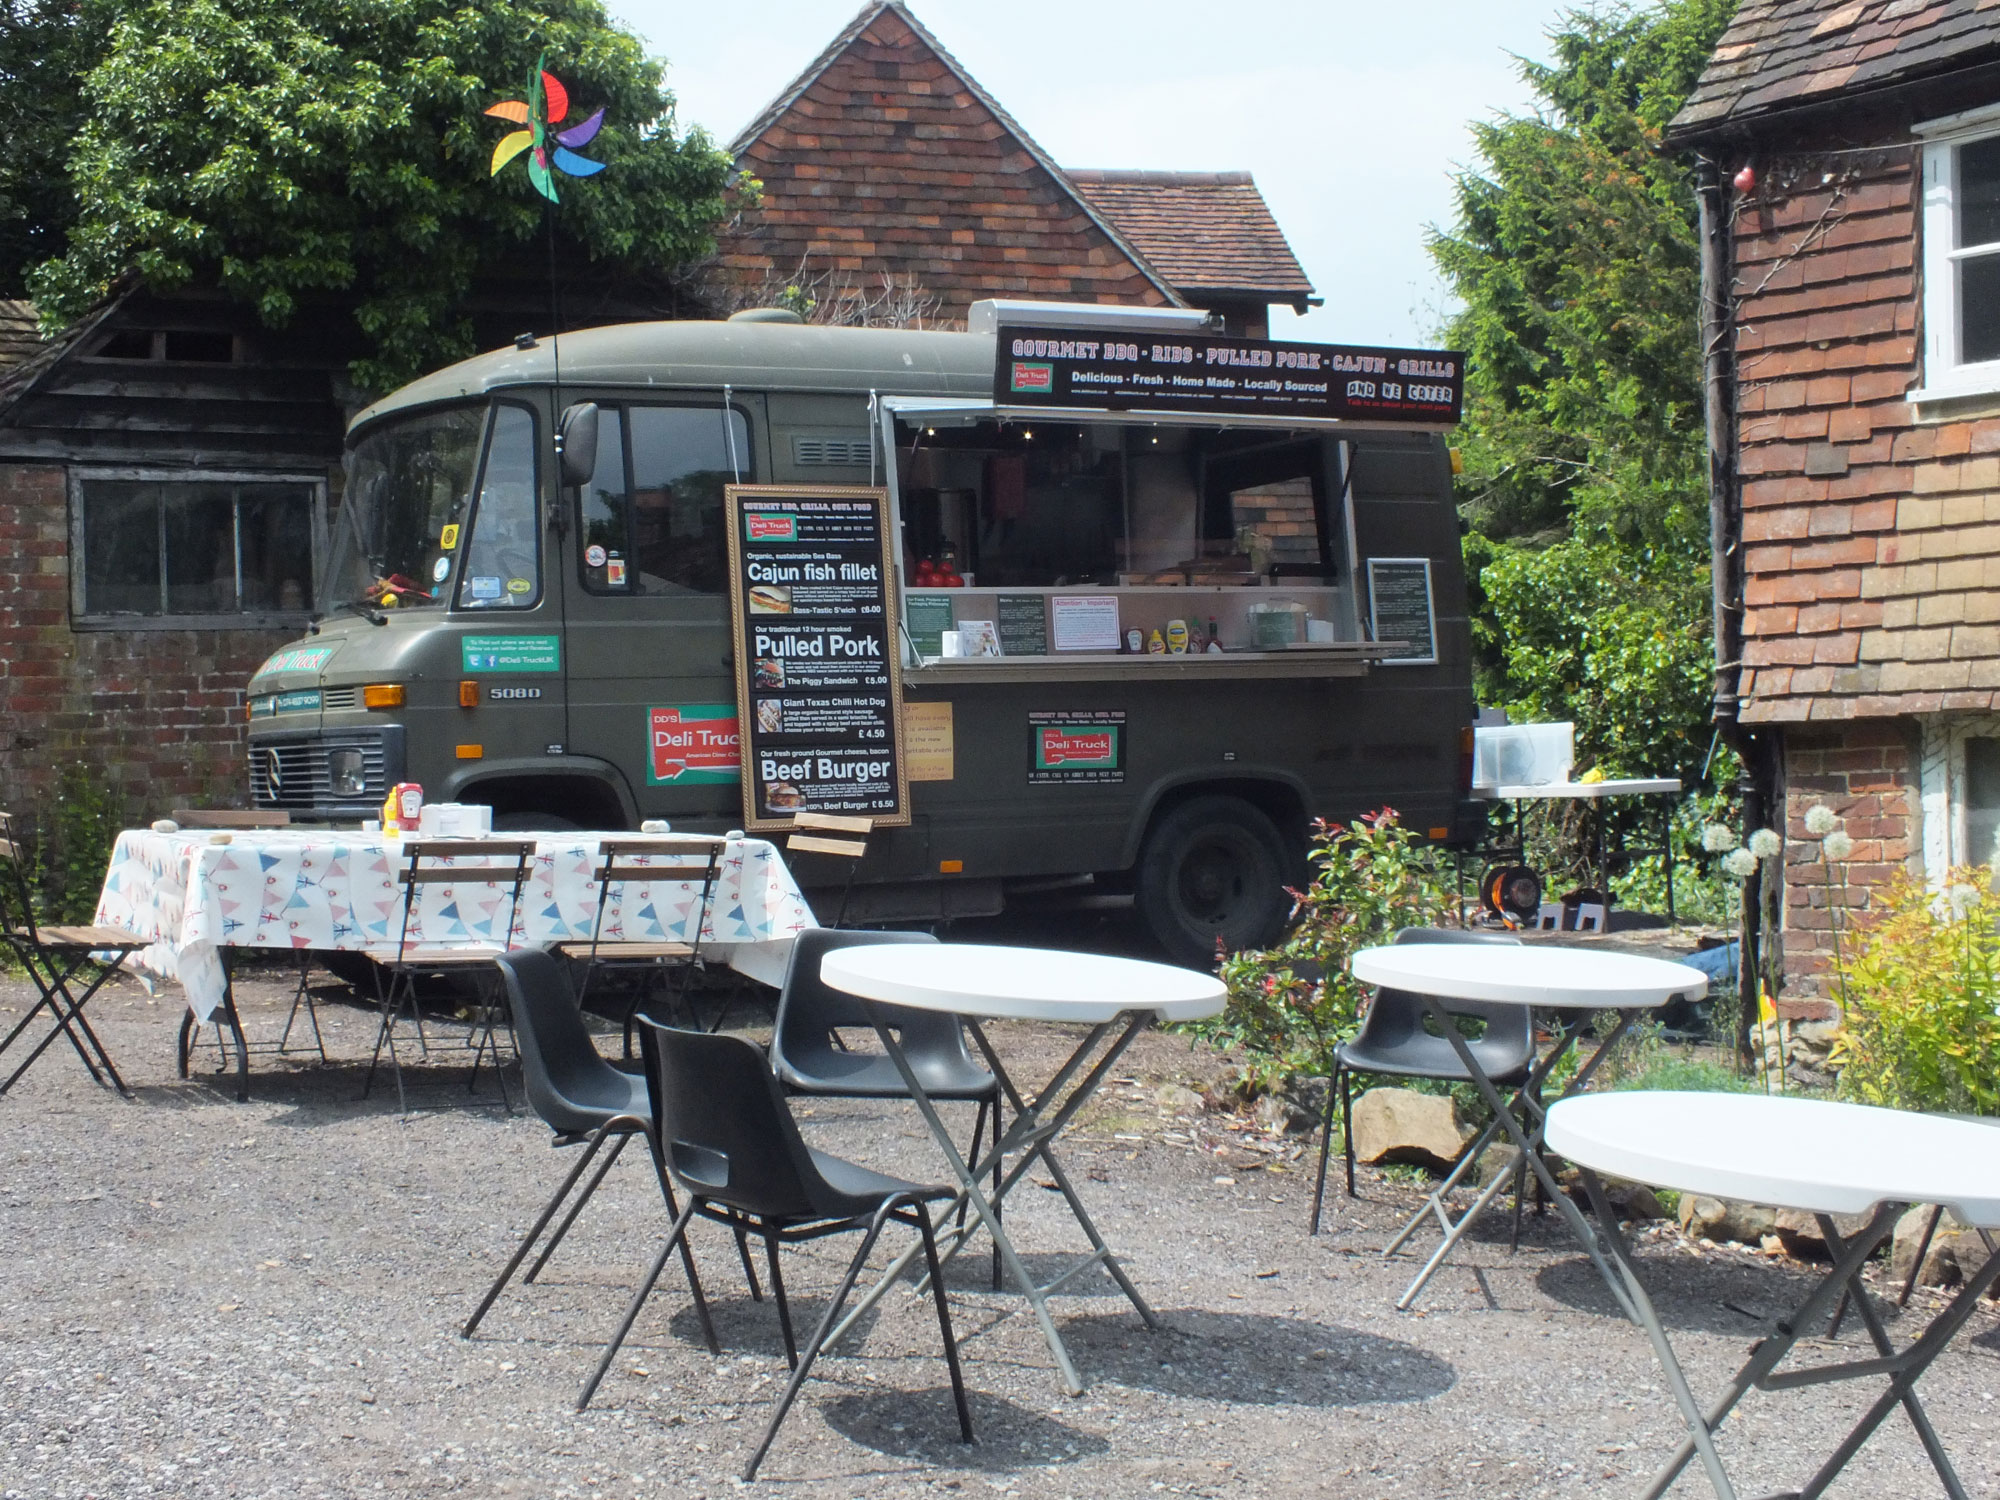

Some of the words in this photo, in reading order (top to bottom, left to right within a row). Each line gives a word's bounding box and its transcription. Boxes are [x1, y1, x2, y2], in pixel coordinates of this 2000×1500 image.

[1012, 339, 1099, 359] GOURMET
[1104, 343, 1138, 361] BBQ
[1152, 345, 1193, 363] RIBS
[1206, 348, 1272, 367] PULLED
[1276, 351, 1321, 369] PORK
[1333, 355, 1387, 374] CAJUN
[1398, 359, 1455, 378] GRILLS
[1072, 372, 1123, 383] Delicious
[1133, 373, 1163, 385] Fresh
[1173, 376, 1204, 387] Home
[1207, 377, 1235, 388] Made
[1244, 379, 1282, 392] Locally
[1284, 381, 1327, 392] Sourced
[1347, 380, 1375, 398] AND
[1382, 382, 1401, 399] WE
[1408, 384, 1453, 403] CATER
[748, 563, 800, 584] Cajun
[804, 563, 835, 580] fish
[840, 563, 877, 580] fillet
[756, 635, 823, 657] Pulled
[830, 635, 880, 657] Pork
[288, 649, 325, 669] Truck
[802, 677, 822, 686] Piggy
[870, 698, 886, 707] Dog
[656, 731, 693, 747] Deli
[696, 730, 740, 746] Truc
[859, 730, 864, 738] £
[866, 729, 885, 738] 4.50
[1045, 740, 1070, 749] Deli
[1072, 740, 1108, 749] Truck
[792, 750, 814, 758] ground
[761, 759, 811, 781] Beef
[818, 758, 890, 782] Burger
[824, 802, 841, 810] Beef
[843, 802, 868, 810] Burger
